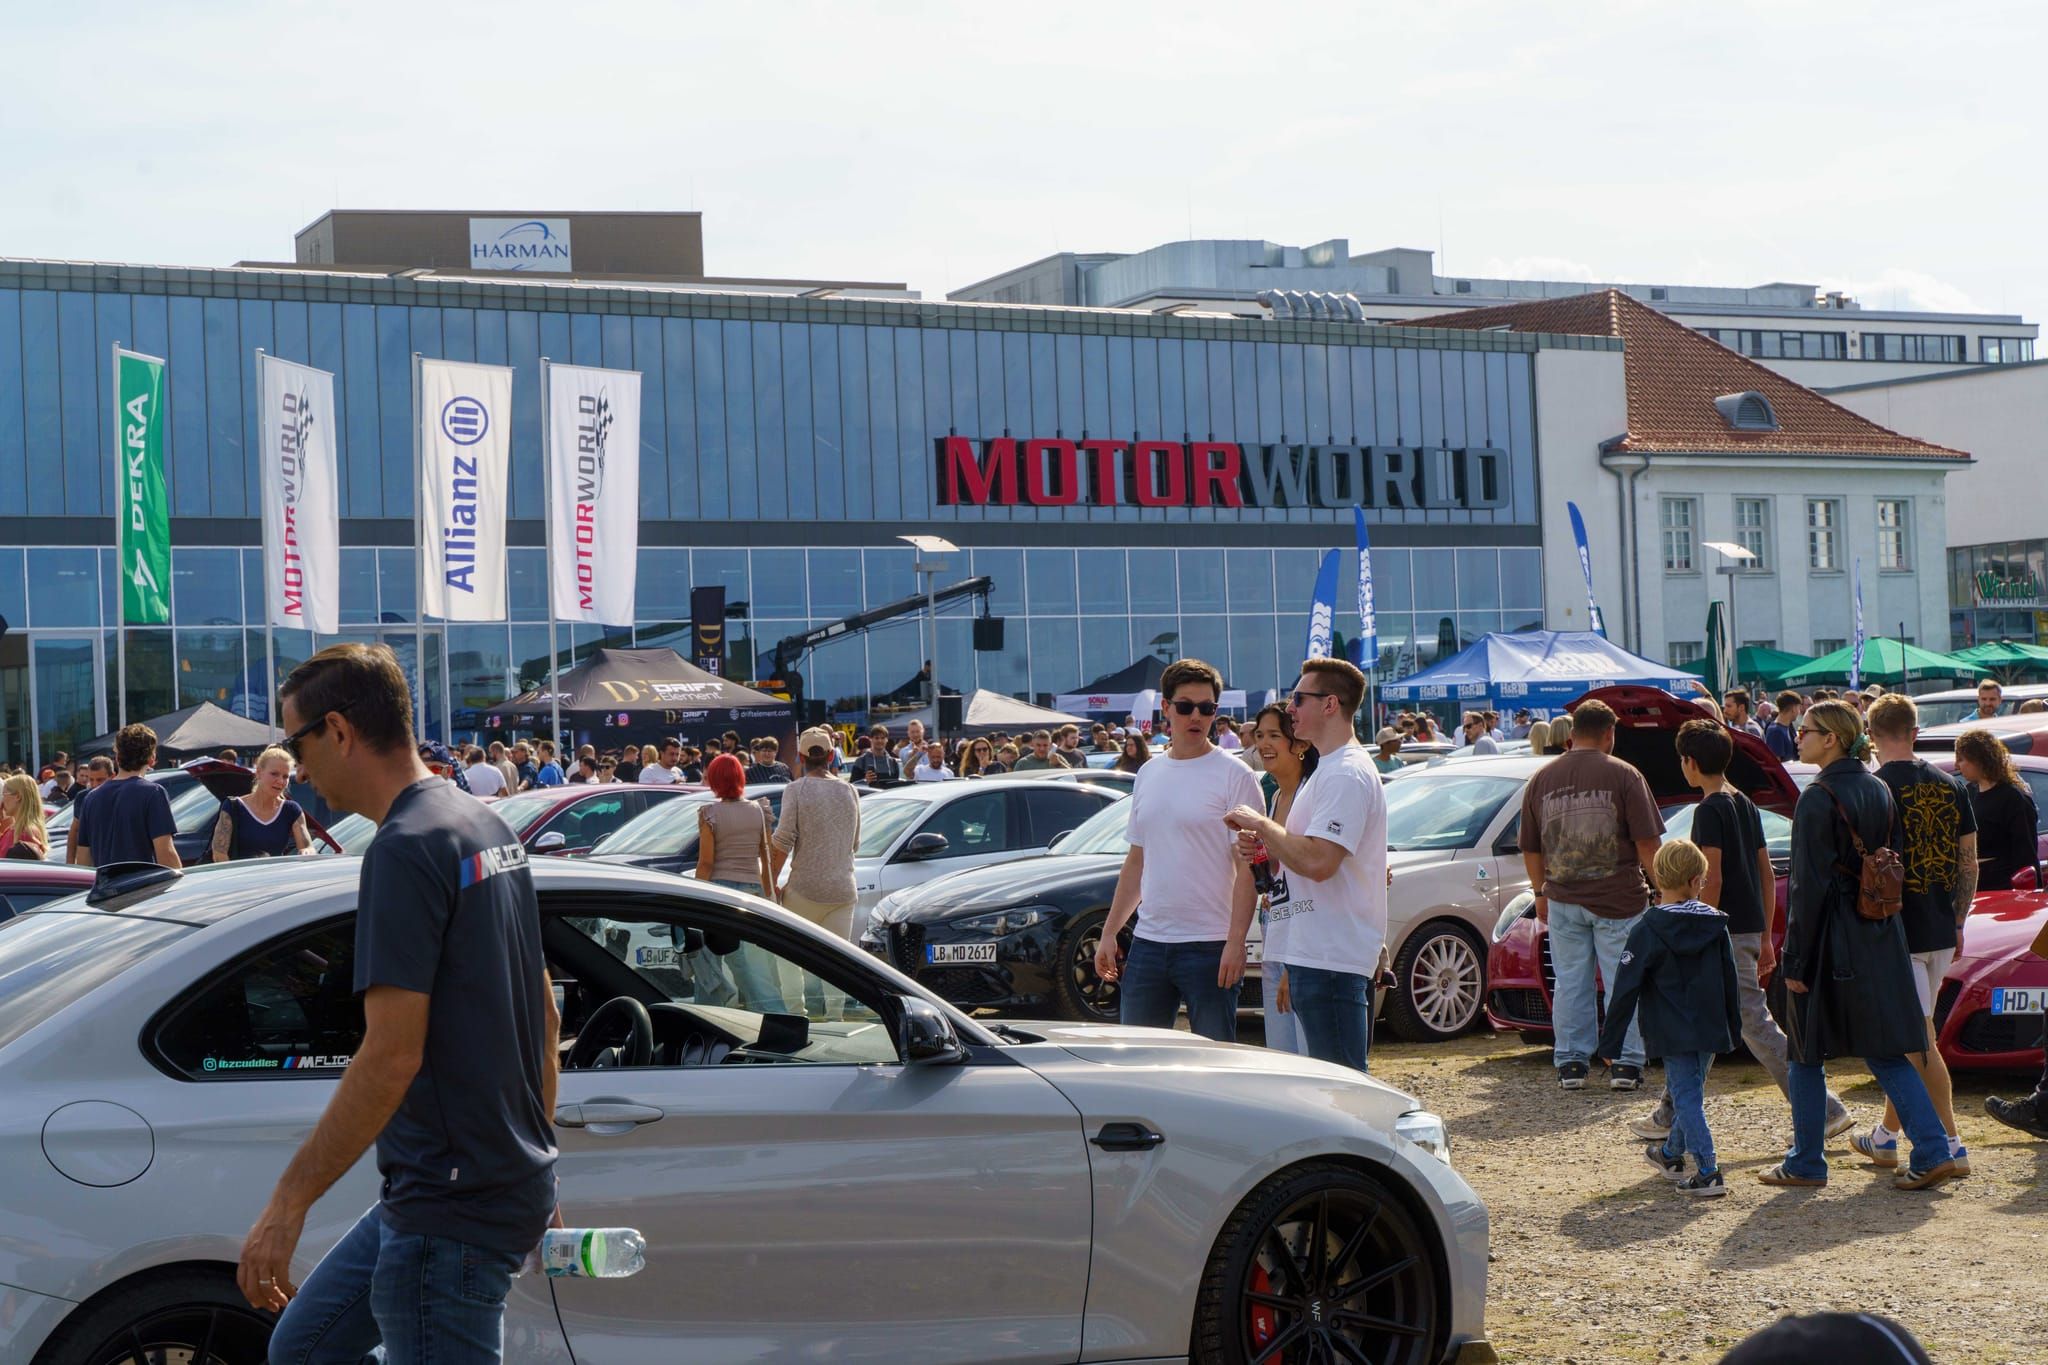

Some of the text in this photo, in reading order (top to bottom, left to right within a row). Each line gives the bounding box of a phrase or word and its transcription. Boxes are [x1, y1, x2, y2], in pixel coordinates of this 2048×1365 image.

[473, 243, 568, 259] HARMAN
[126, 393, 149, 532] DEKRA
[943, 434, 1510, 509] MOTORWORLD
[576, 395, 596, 610] MOTORWORLD
[444, 456, 477, 594] Allianz
[651, 682, 724, 692] DRIFT
[661, 691, 723, 702] Element
[740, 709, 791, 719] driftelement.com
[933, 945, 995, 960] LB MD 2617
[2003, 991, 2029, 1011] HD
